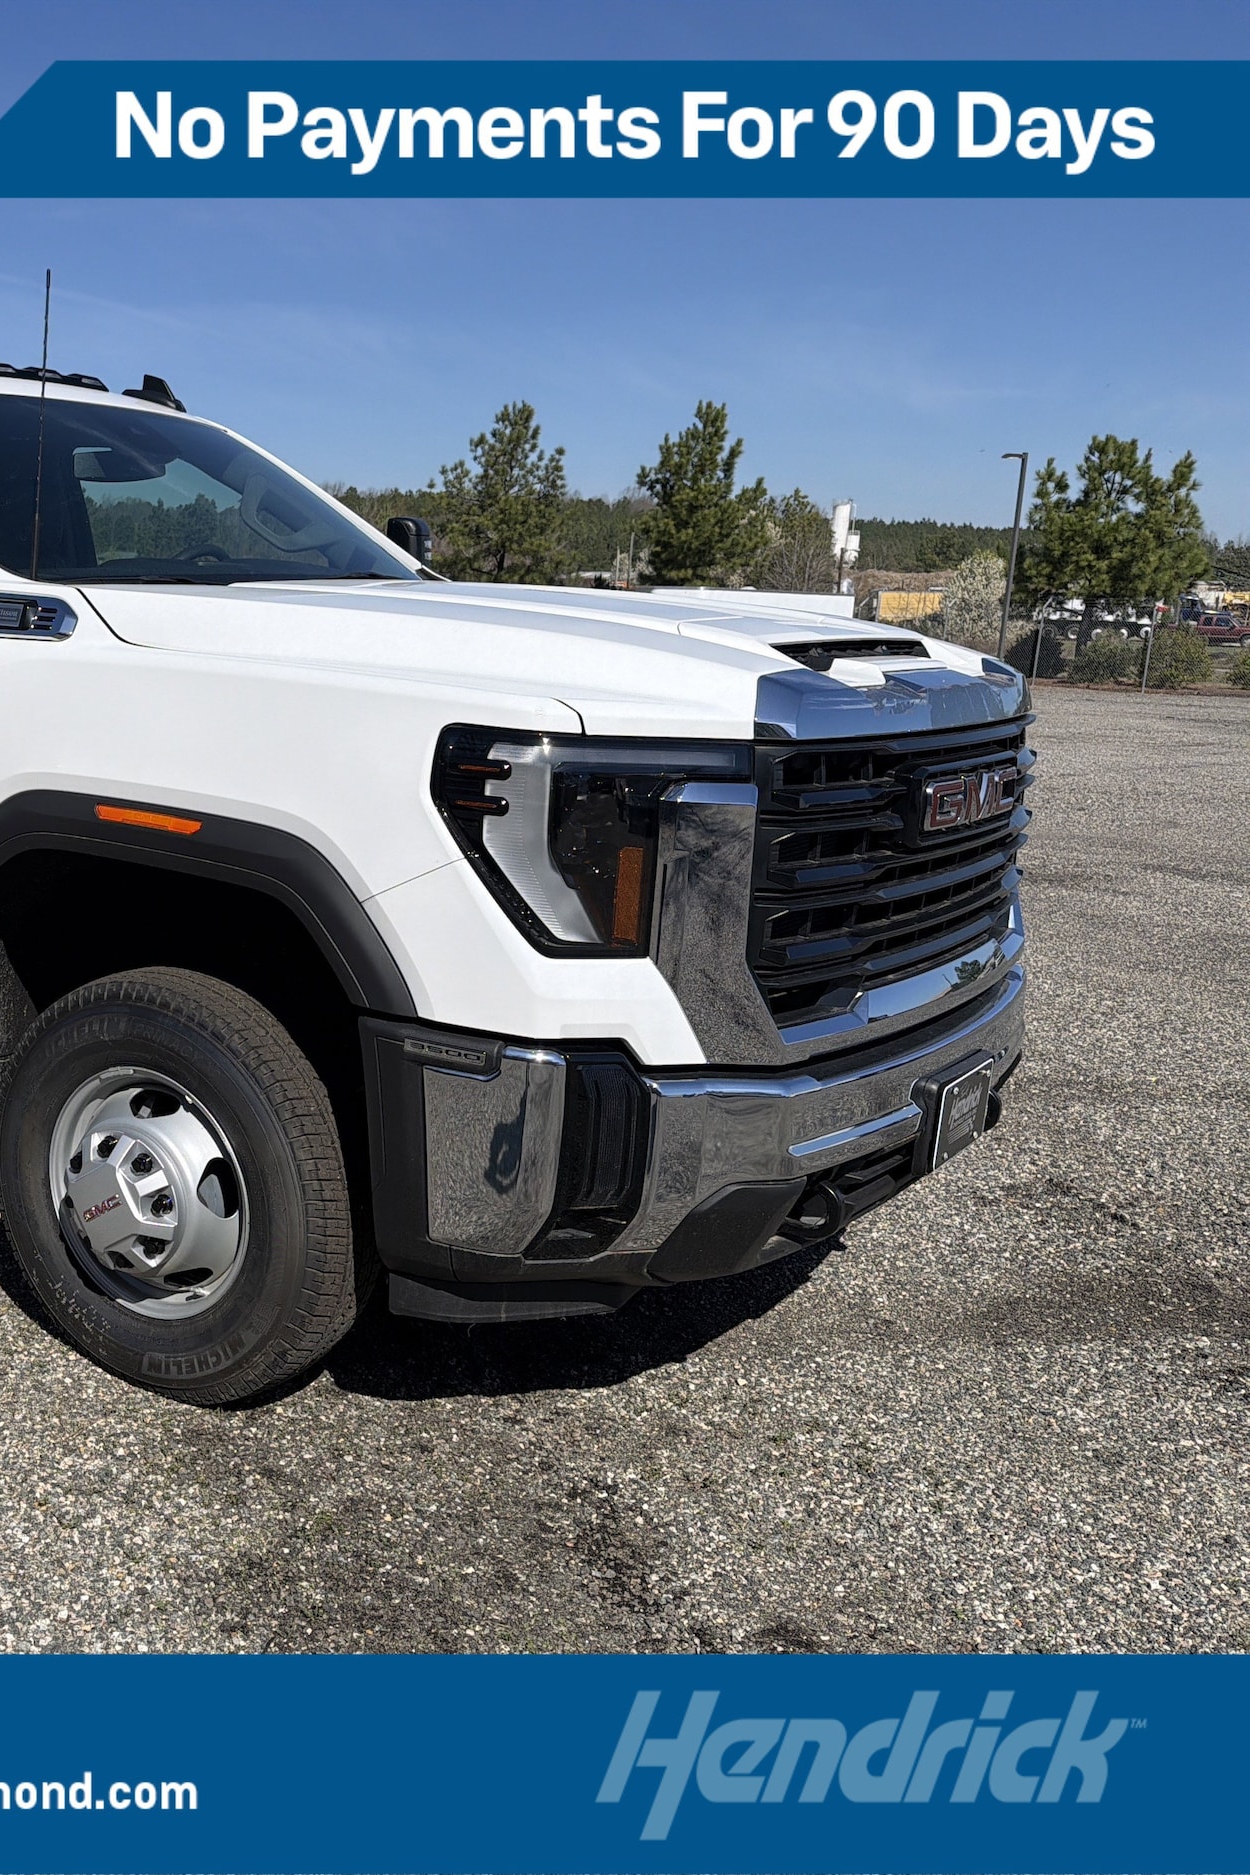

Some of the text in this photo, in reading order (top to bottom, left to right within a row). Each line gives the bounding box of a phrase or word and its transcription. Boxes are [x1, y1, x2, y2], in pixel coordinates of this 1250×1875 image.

[924, 766, 1017, 831] GMC
[409, 1041, 481, 1061] 3500
[83, 1193, 123, 1222] GMC
[147, 1334, 245, 1375] MICHELIN
